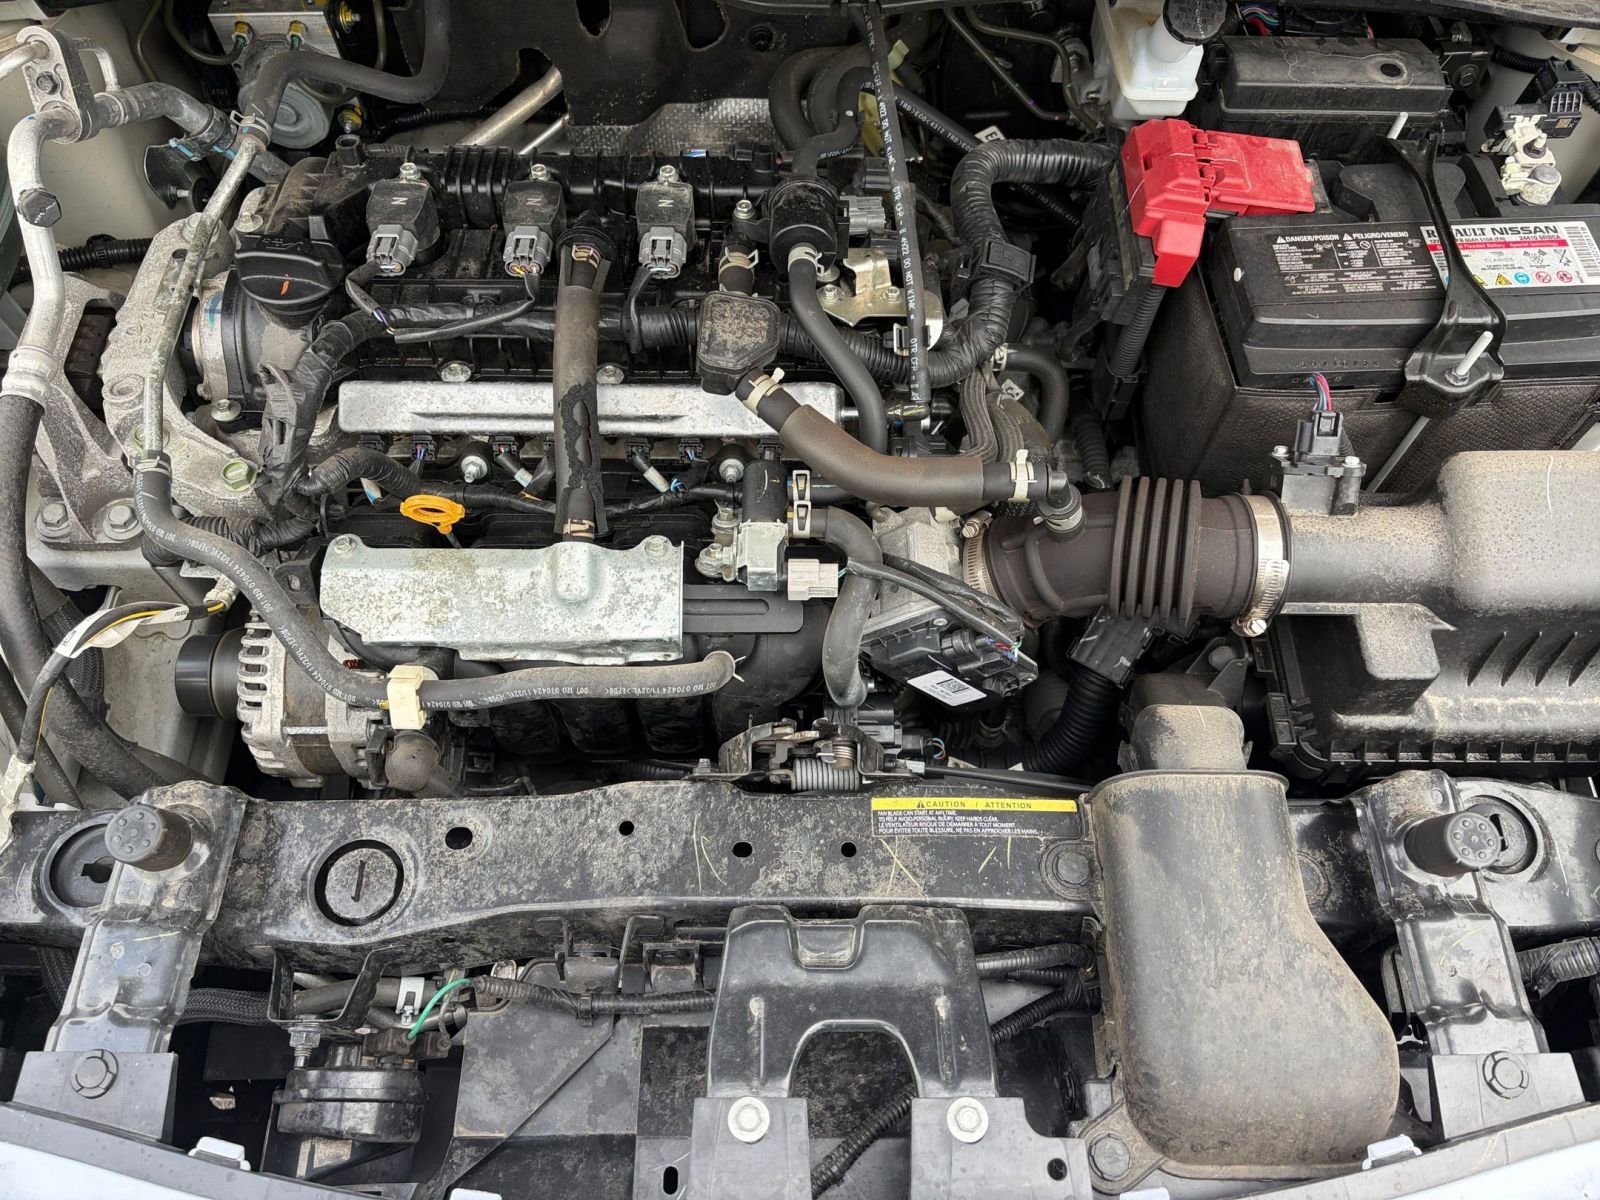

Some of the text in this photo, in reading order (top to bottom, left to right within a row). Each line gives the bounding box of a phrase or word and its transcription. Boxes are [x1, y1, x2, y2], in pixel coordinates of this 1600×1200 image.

[1285, 234, 1339, 242] DANGER/POISON
[1352, 231, 1409, 240] PELIGRO/VENENO
[1424, 225, 1559, 239] RAULT NISSAN
[906, 289, 916, 311] KINK
[910, 337, 918, 353] DTR
[233, 564, 256, 588] 070424
[260, 599, 273, 613] DOT
[312, 669, 332, 691] 070424
[533, 686, 561, 695] 070424
[661, 685, 692, 694] 070424
[985, 801, 1033, 809] ATTENTION
